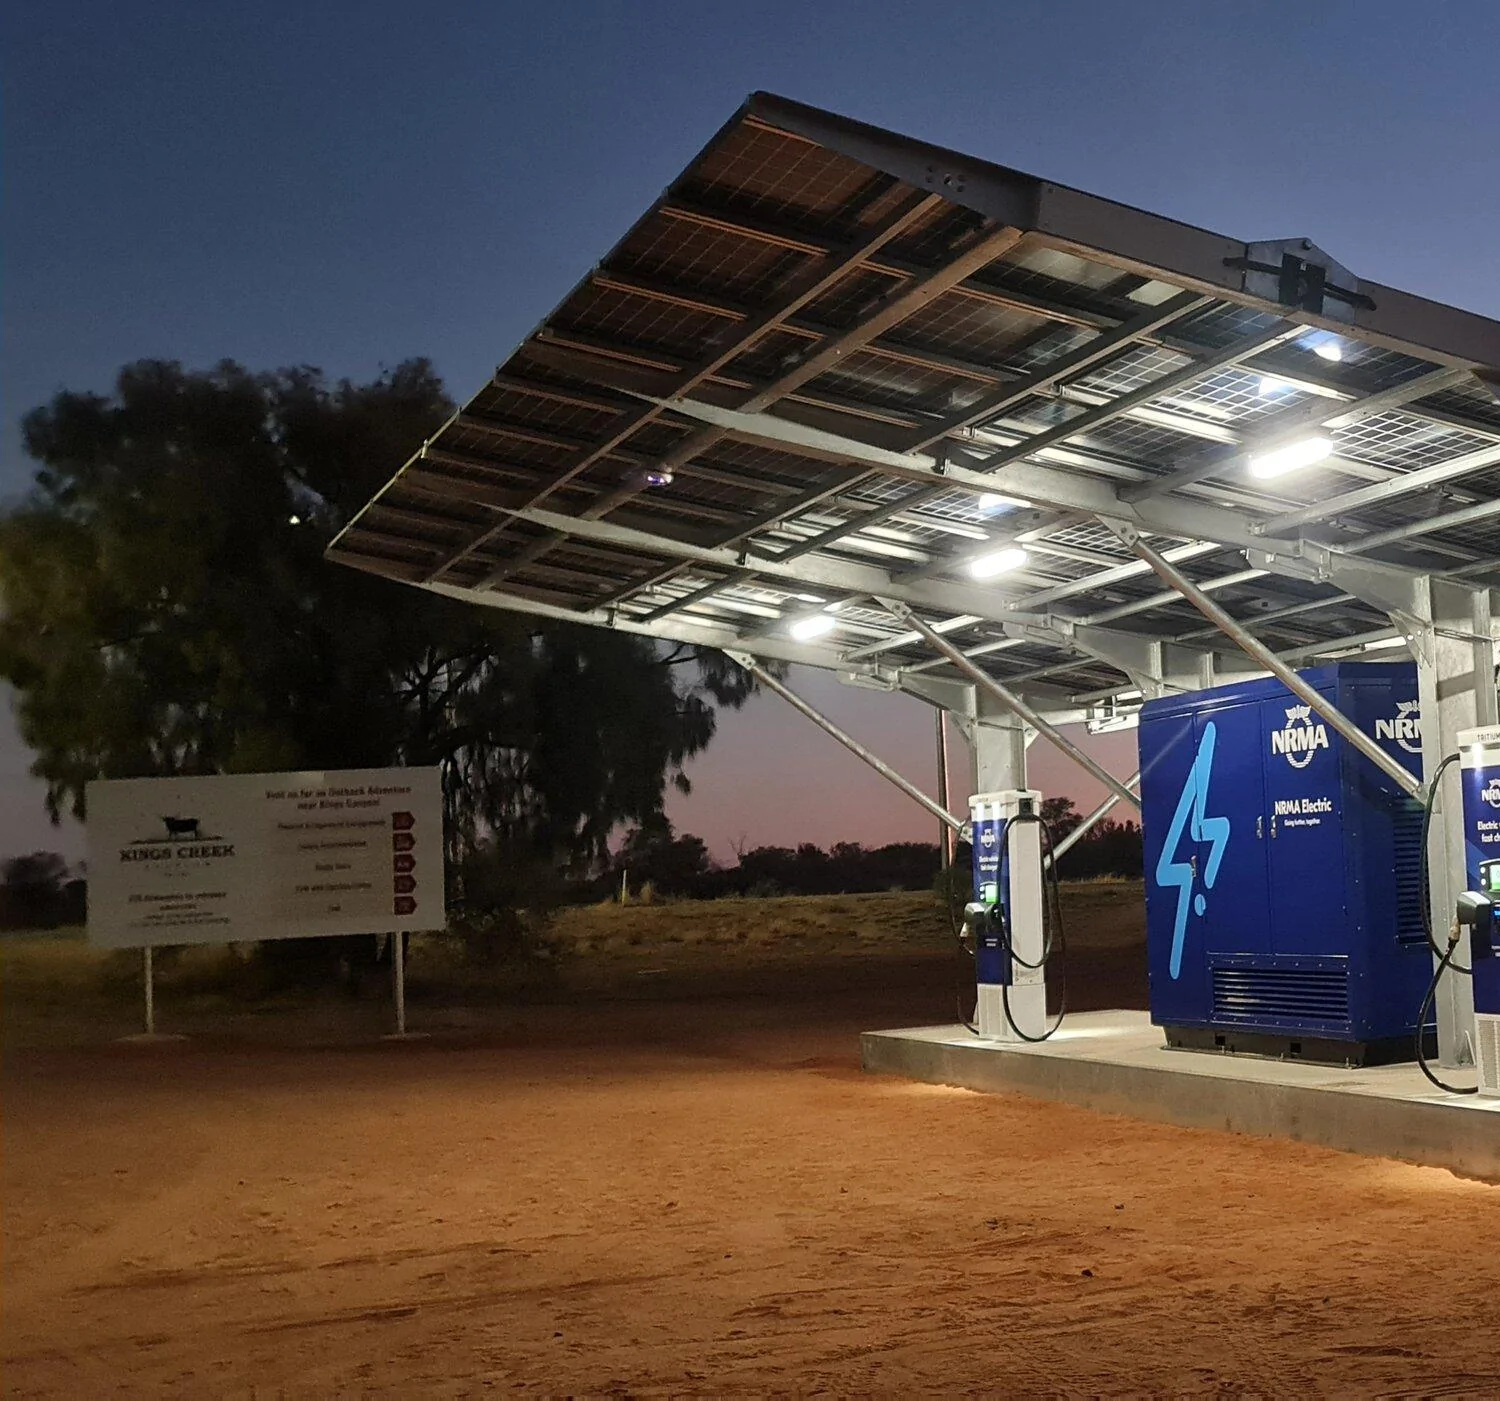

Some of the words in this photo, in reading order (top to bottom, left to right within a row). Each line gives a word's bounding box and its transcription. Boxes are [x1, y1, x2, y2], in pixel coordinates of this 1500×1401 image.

[1375, 718, 1422, 740] NR
[1477, 732, 1500, 741] TRITIUM
[1271, 724, 1329, 754] NRMA
[1274, 800, 1301, 815] NRMA
[1301, 797, 1332, 813] Electric
[1477, 820, 1498, 831] Electric
[1481, 833, 1493, 843] fast
[120, 847, 172, 862] KINGS
[177, 844, 236, 859] CREEK
